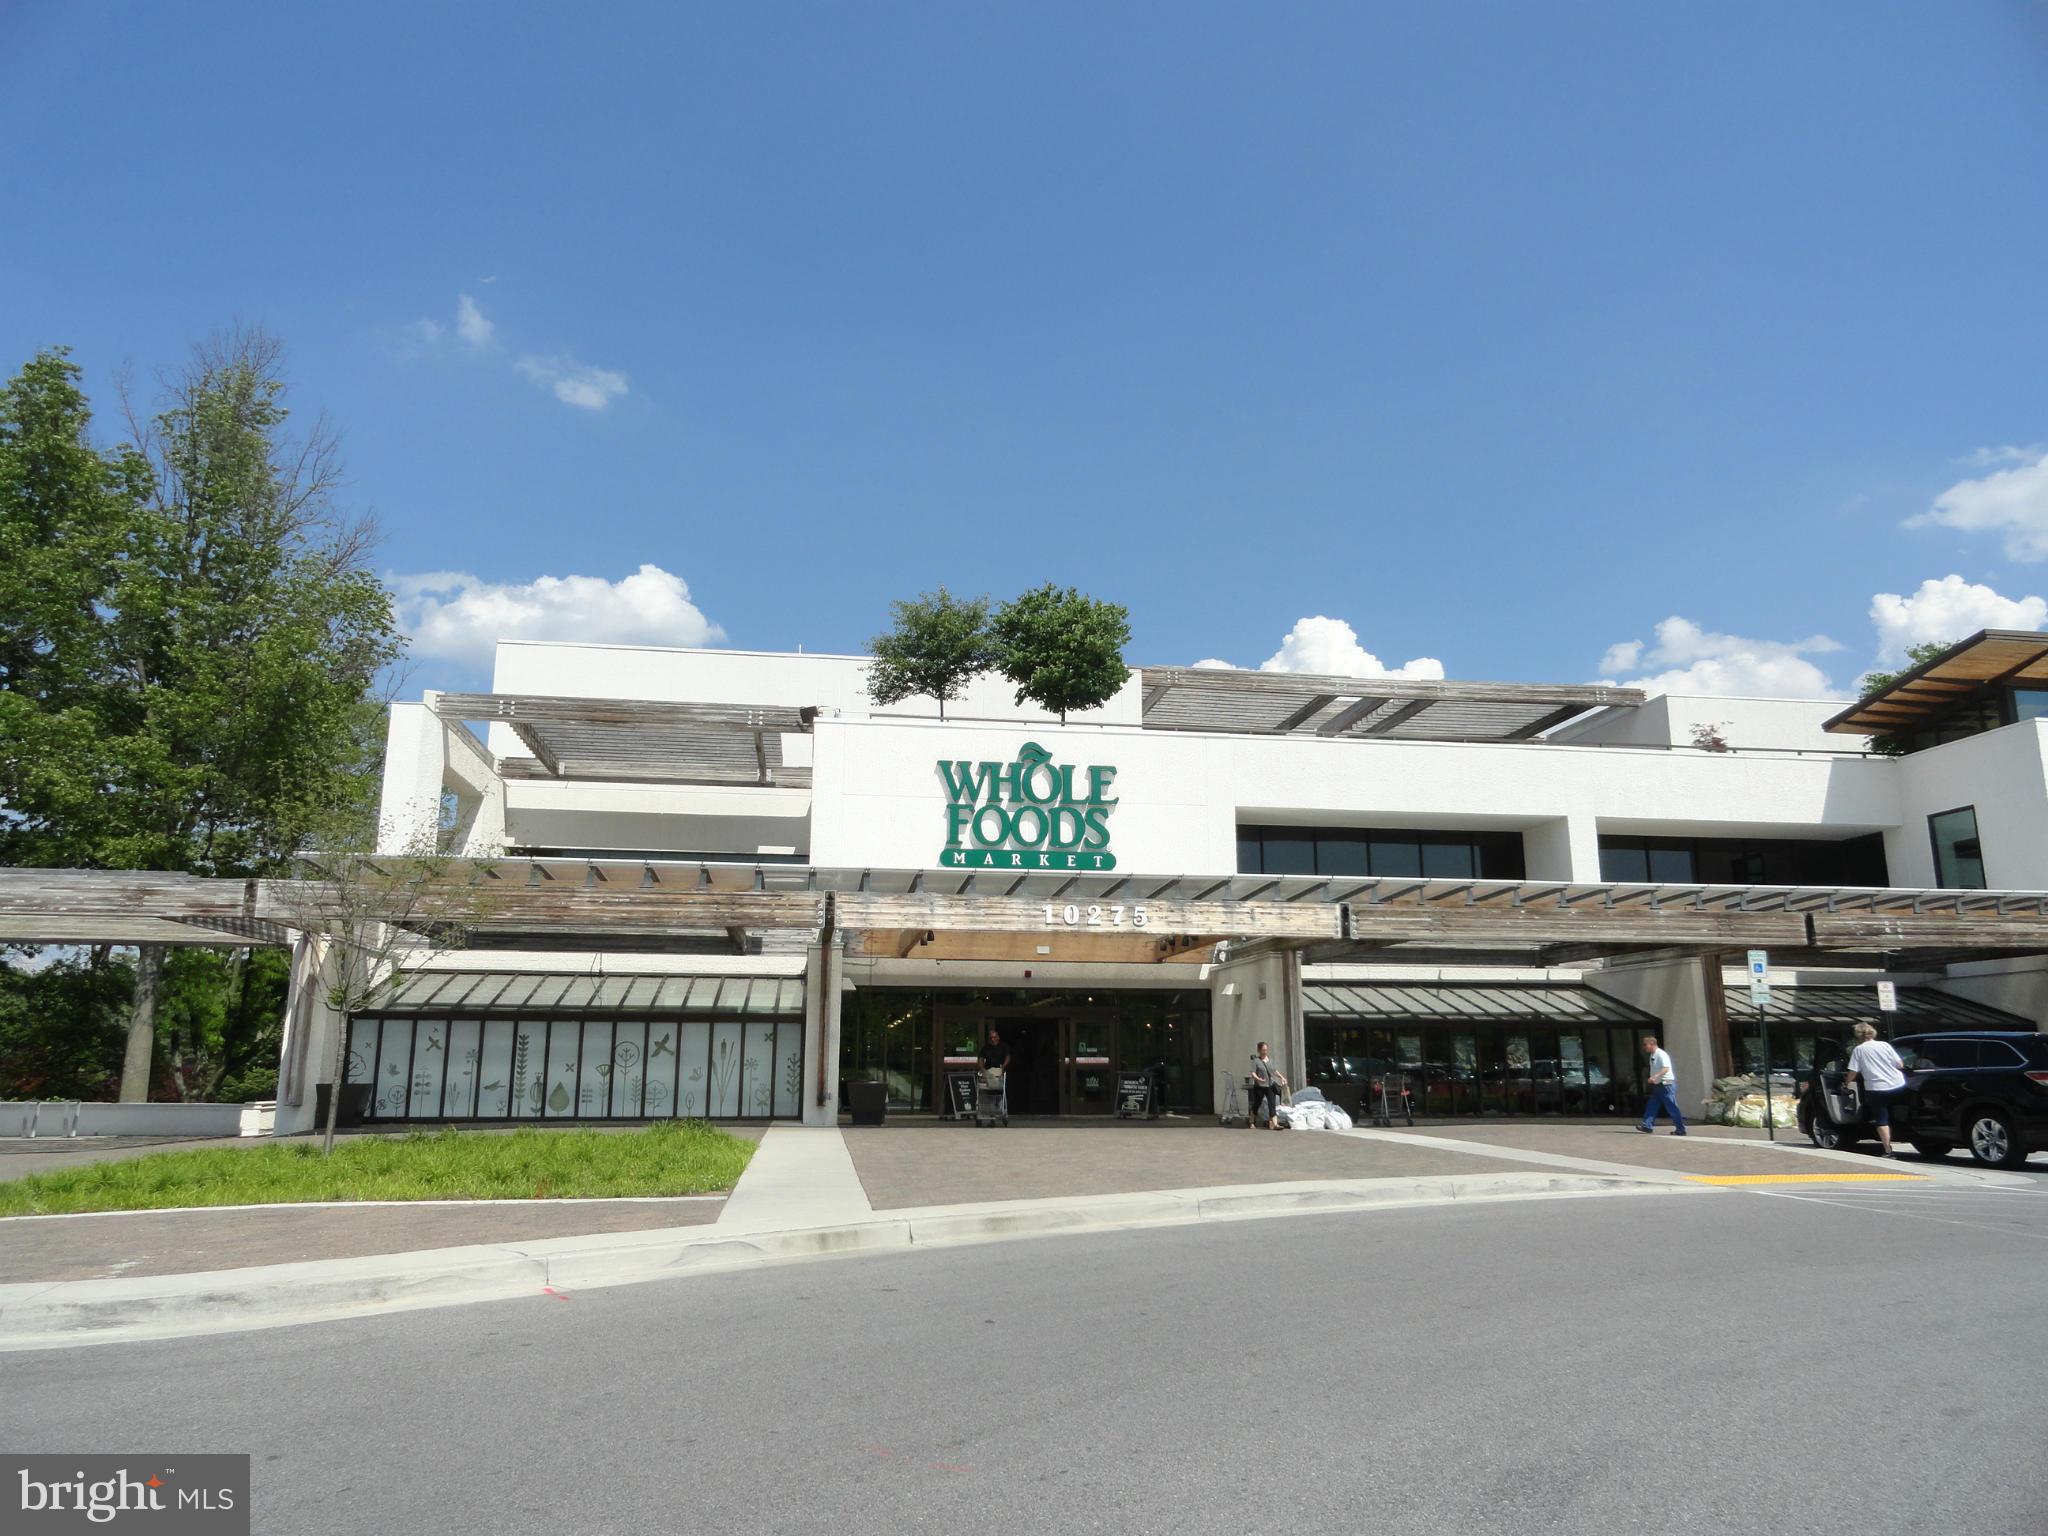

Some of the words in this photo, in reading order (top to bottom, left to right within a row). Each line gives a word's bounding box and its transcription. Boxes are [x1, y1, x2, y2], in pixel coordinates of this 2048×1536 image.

[936, 759, 1120, 805] WHOLE
[946, 803, 1111, 849] FOODS
[953, 852, 1103, 867] MARKET
[1042, 904, 1149, 927] 10275
